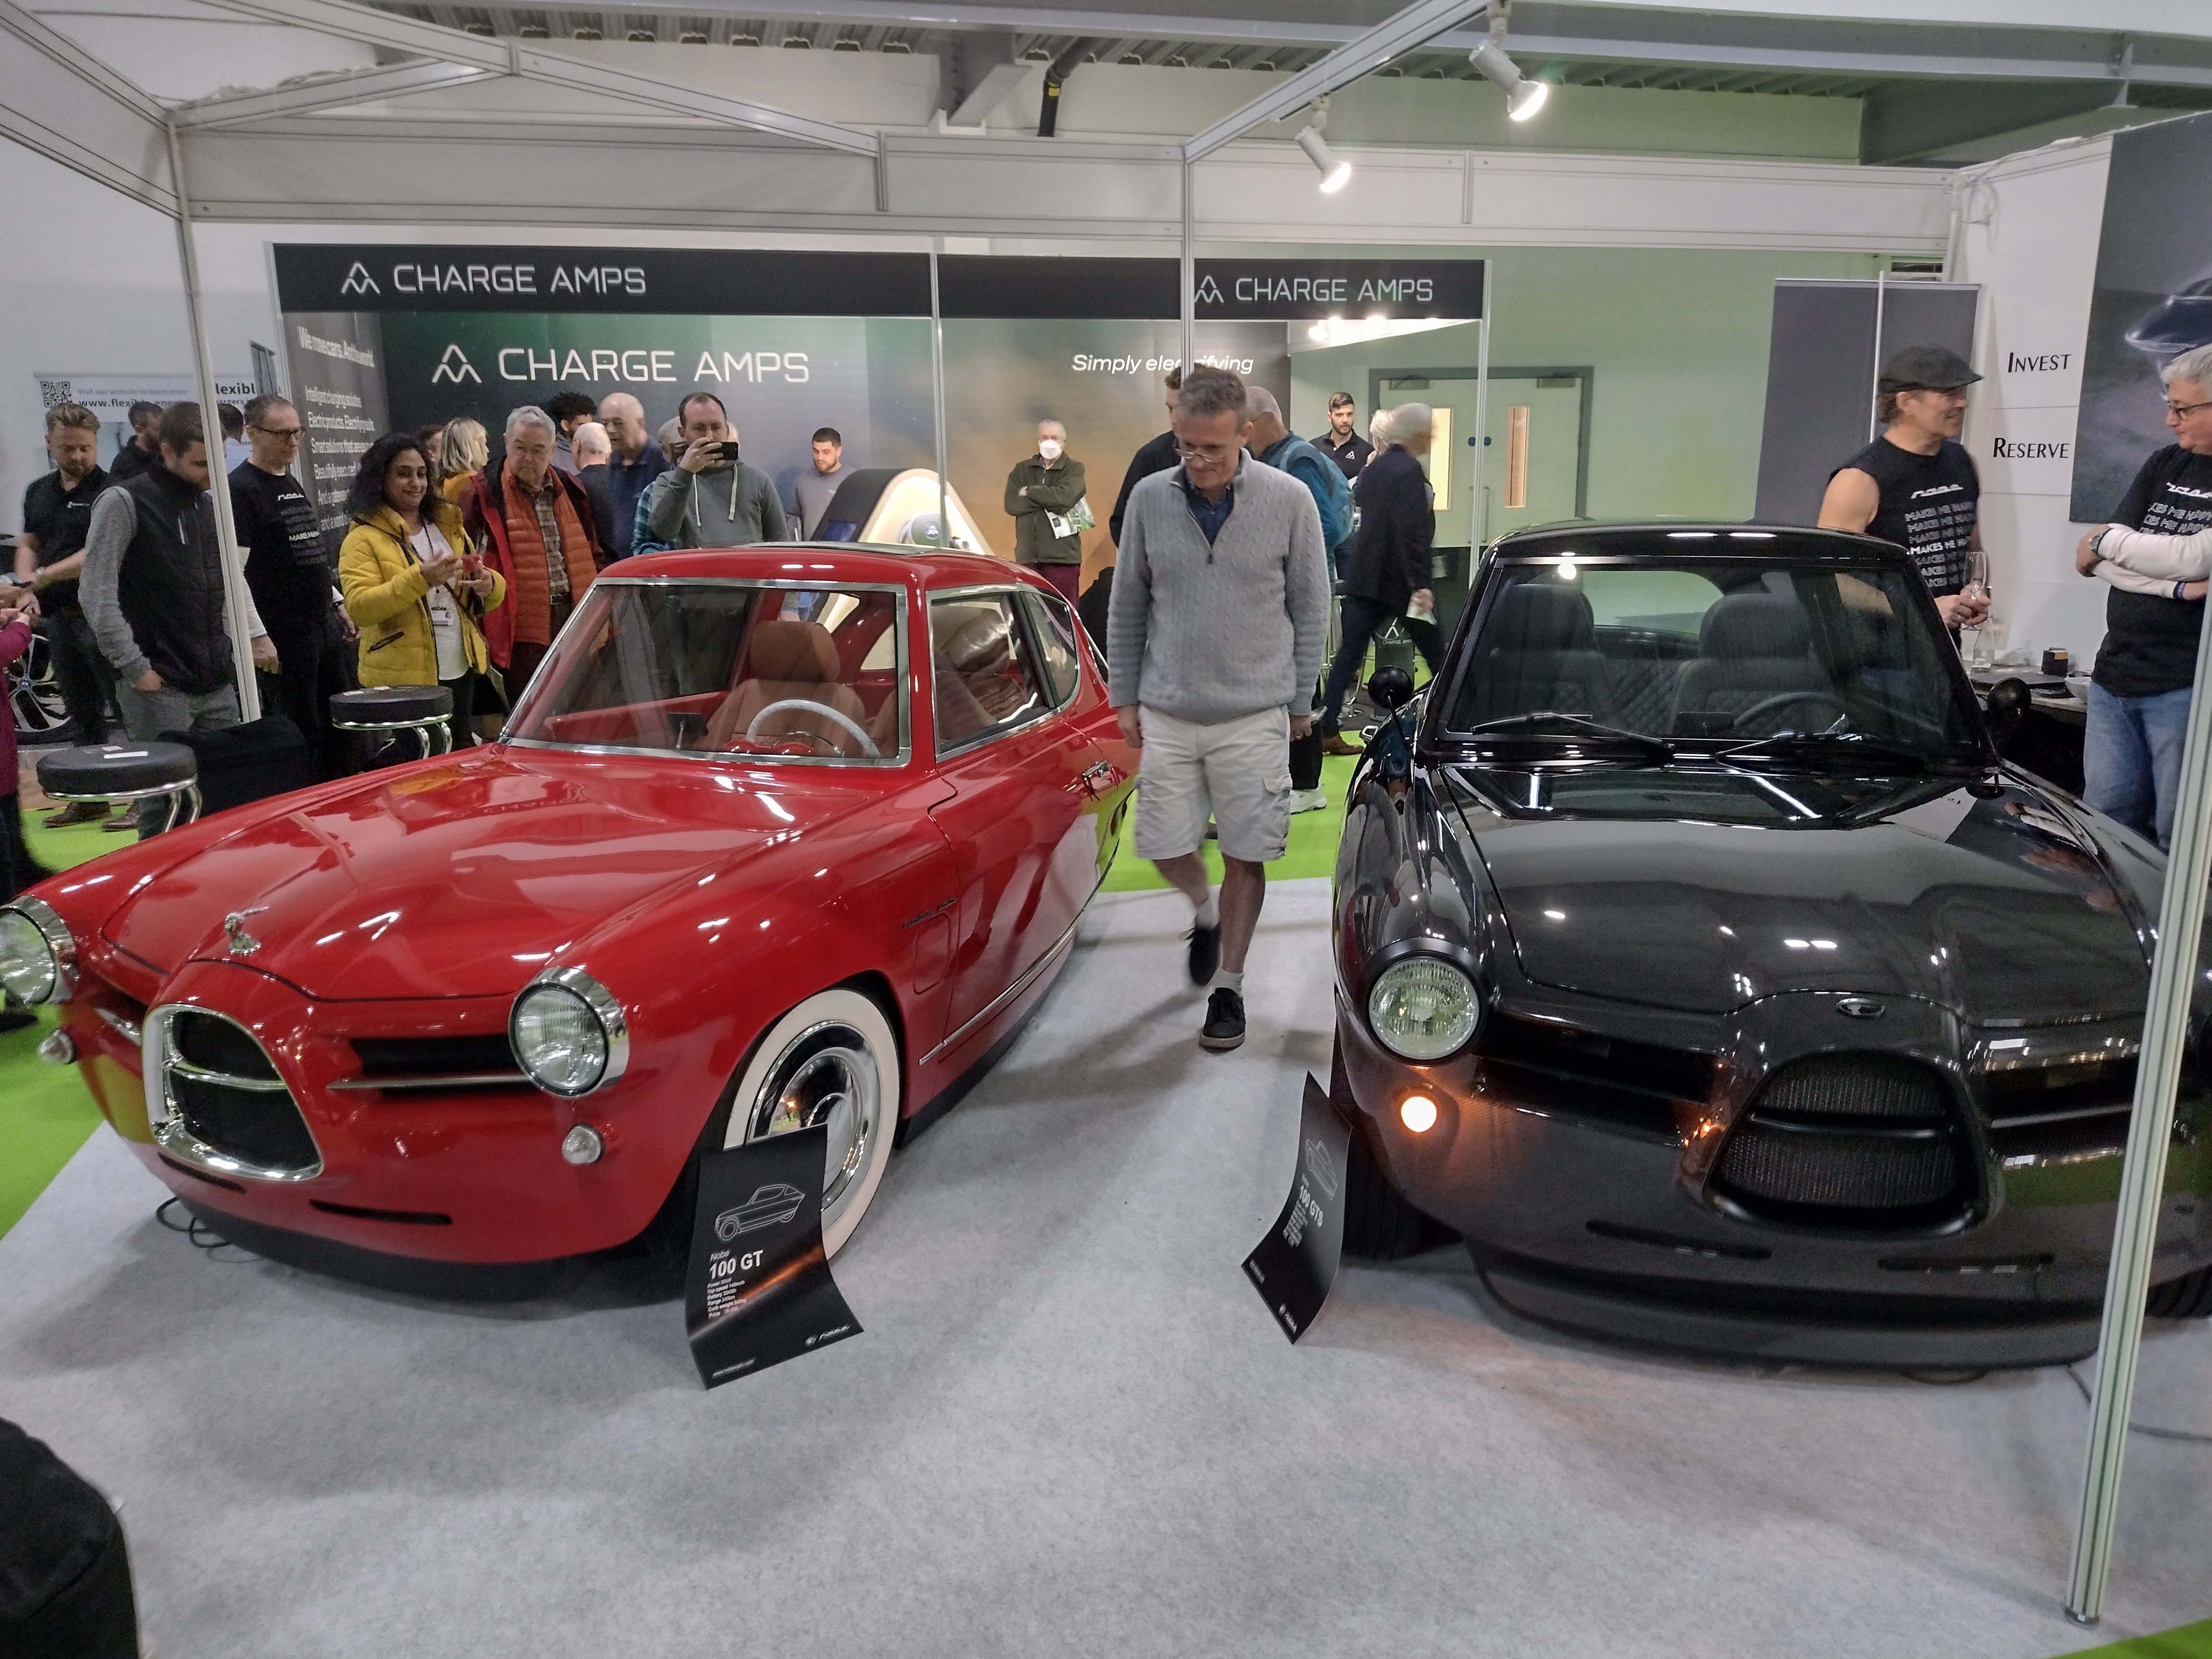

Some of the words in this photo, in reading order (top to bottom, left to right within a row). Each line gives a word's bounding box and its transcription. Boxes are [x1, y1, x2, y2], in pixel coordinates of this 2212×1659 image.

[394, 264, 537, 293] CHARGE
[551, 266, 647, 295] AMPS
[1235, 277, 1348, 302] CHARGE
[1358, 278, 1433, 302] AMPS
[498, 347, 677, 382] CHARGE
[694, 350, 809, 383] AMPS
[1070, 354, 1142, 375] Simply
[2008, 352, 2071, 373] INVEST
[1993, 437, 2070, 459] RESERVE
[2167, 505, 2186, 519] ME
[2160, 518, 2178, 530] ME
[1910, 542, 1943, 555] MAKES
[1299, 1185, 1311, 1208] 100
[1310, 1200, 1323, 1227] GTS
[709, 1258, 736, 1280] 100
[740, 1250, 764, 1270] GT
